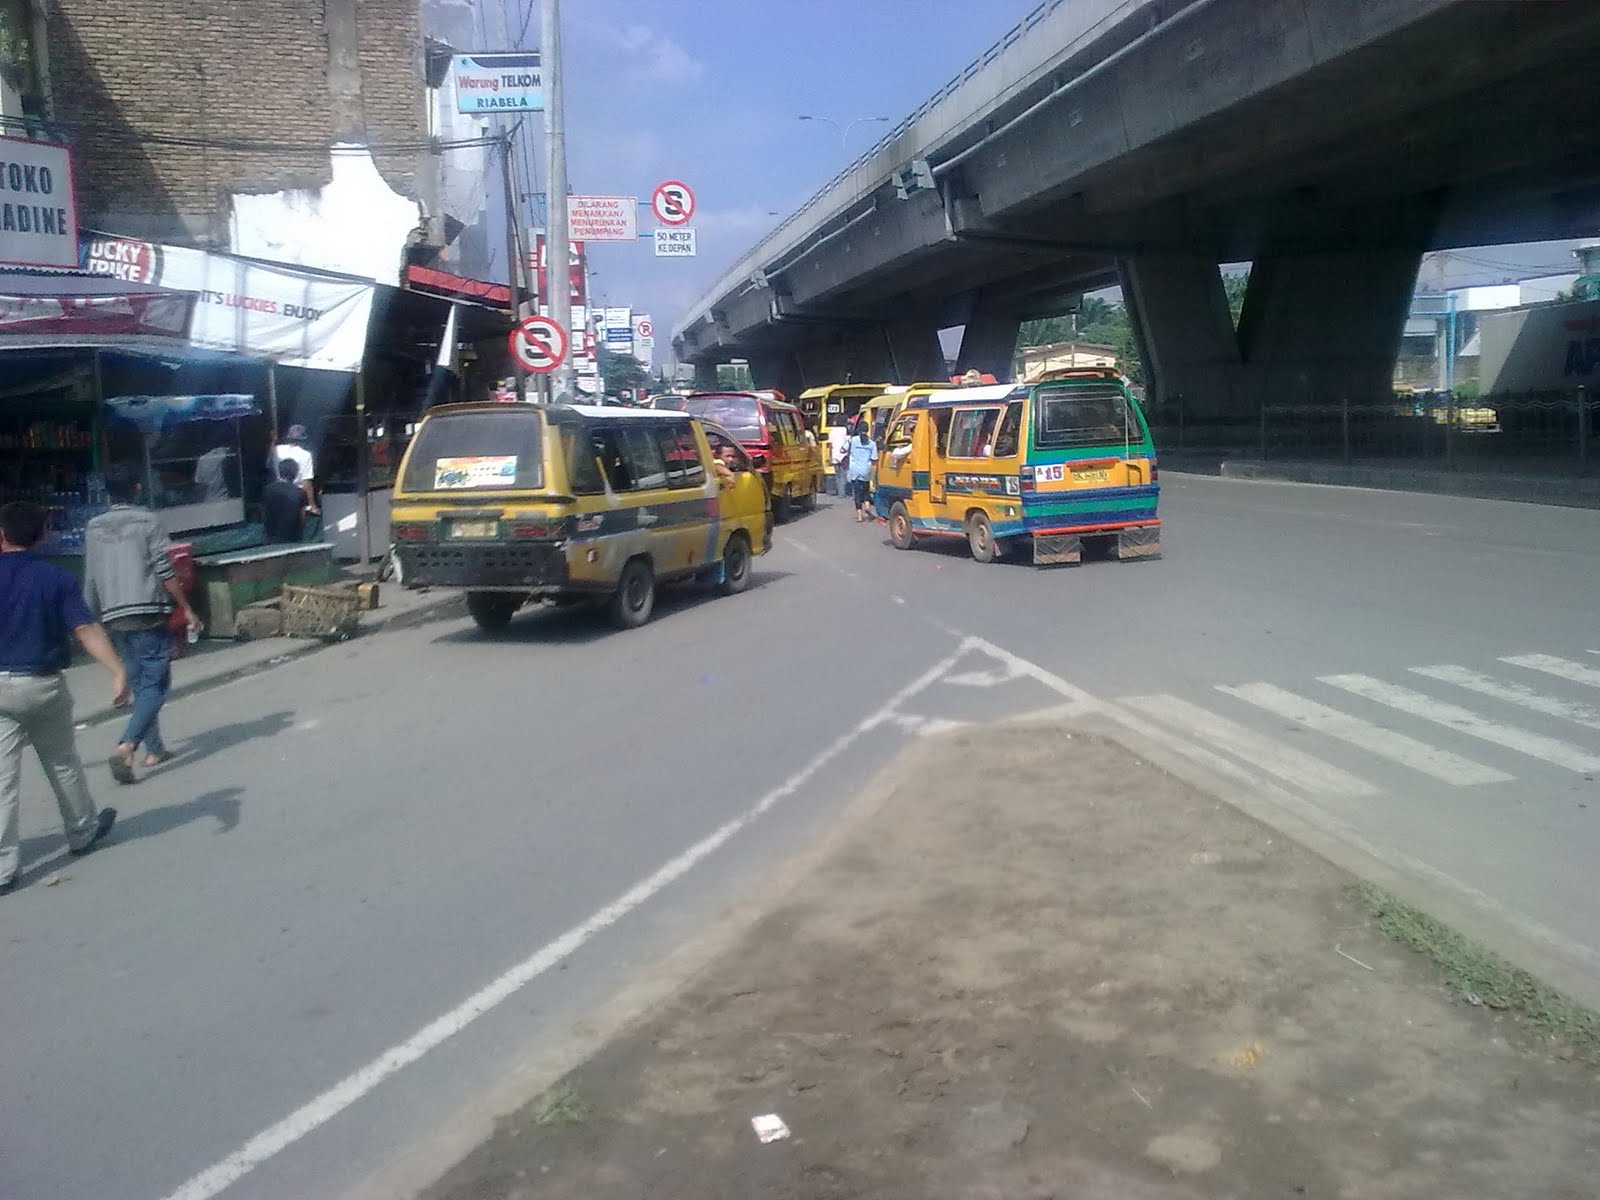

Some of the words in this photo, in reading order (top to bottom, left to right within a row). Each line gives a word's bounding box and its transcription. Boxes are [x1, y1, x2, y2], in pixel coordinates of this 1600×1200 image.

[458, 75, 499, 91] Warung
[501, 74, 541, 88] TELKOM
[477, 97, 528, 108] RIABELA
[0, 161, 53, 194] TOKO
[577, 201, 619, 209] DILARANG
[0, 203, 68, 236] ADINE
[571, 210, 625, 218] MENAIKKAN/
[570, 219, 627, 227] MENURUNKAN
[574, 228, 624, 236] PENUMPANG
[657, 232, 668, 241] 50
[669, 232, 692, 241] METER
[91, 240, 143, 264] UCKY
[658, 244, 668, 252] KE
[669, 244, 692, 252] DEPAN
[88, 258, 142, 282] TRIKE
[201, 289, 225, 305] IT'S
[283, 303, 323, 321] ENJOY
[1044, 465, 1063, 480] 15
